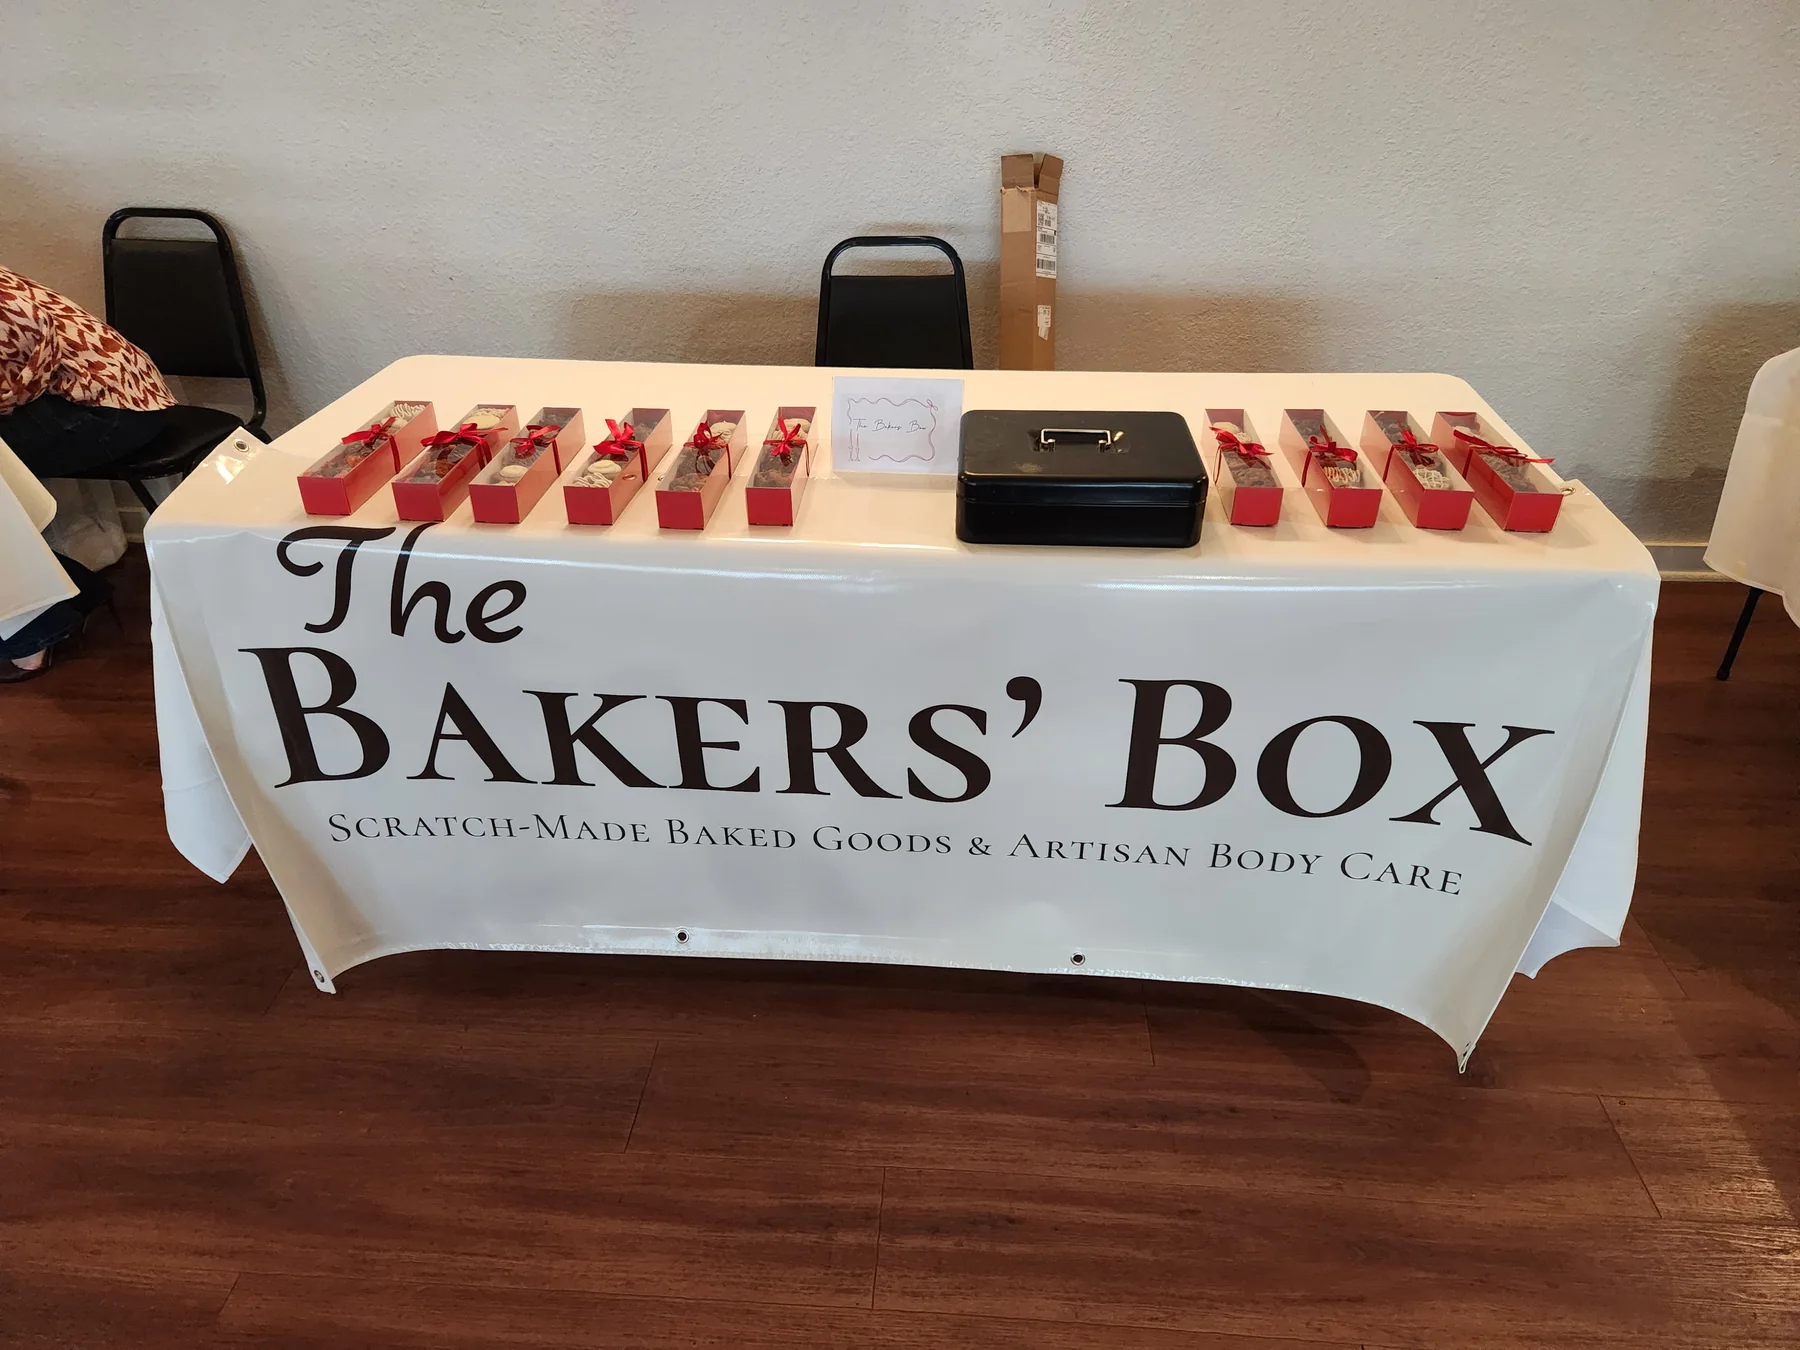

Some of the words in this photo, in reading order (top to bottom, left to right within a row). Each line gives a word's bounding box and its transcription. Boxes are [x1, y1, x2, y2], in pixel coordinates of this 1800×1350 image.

[853, 418, 868, 431] The
[276, 521, 527, 644] The
[1104, 675, 1556, 847] BOX
[328, 813, 650, 843] SCRATCH-MADE
[665, 818, 796, 849] BAKED
[812, 825, 952, 854] GOODS
[968, 836, 992, 856] &
[1008, 833, 1190, 867] ARTISAN
[1209, 843, 1324, 875] BODY
[1340, 853, 1462, 896] CARE
